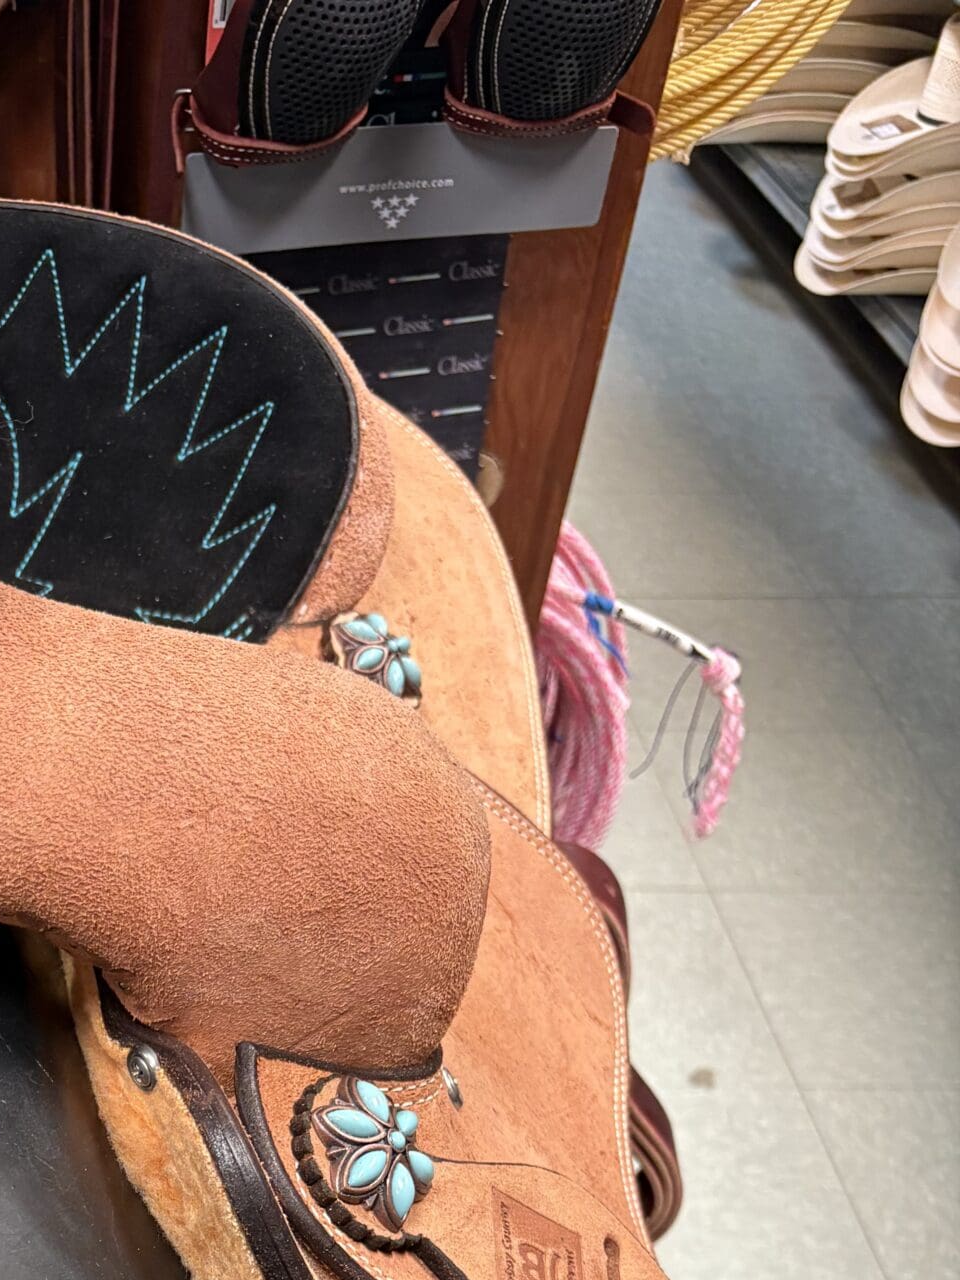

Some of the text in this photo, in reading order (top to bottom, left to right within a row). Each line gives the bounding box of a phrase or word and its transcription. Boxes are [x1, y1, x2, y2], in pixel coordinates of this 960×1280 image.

[339, 179, 454, 194] www.profchoice.com
[448, 259, 495, 282] Classic
[328, 273, 375, 296] Classic
[383, 314, 431, 337] Classic
[437, 353, 485, 376] Classic
